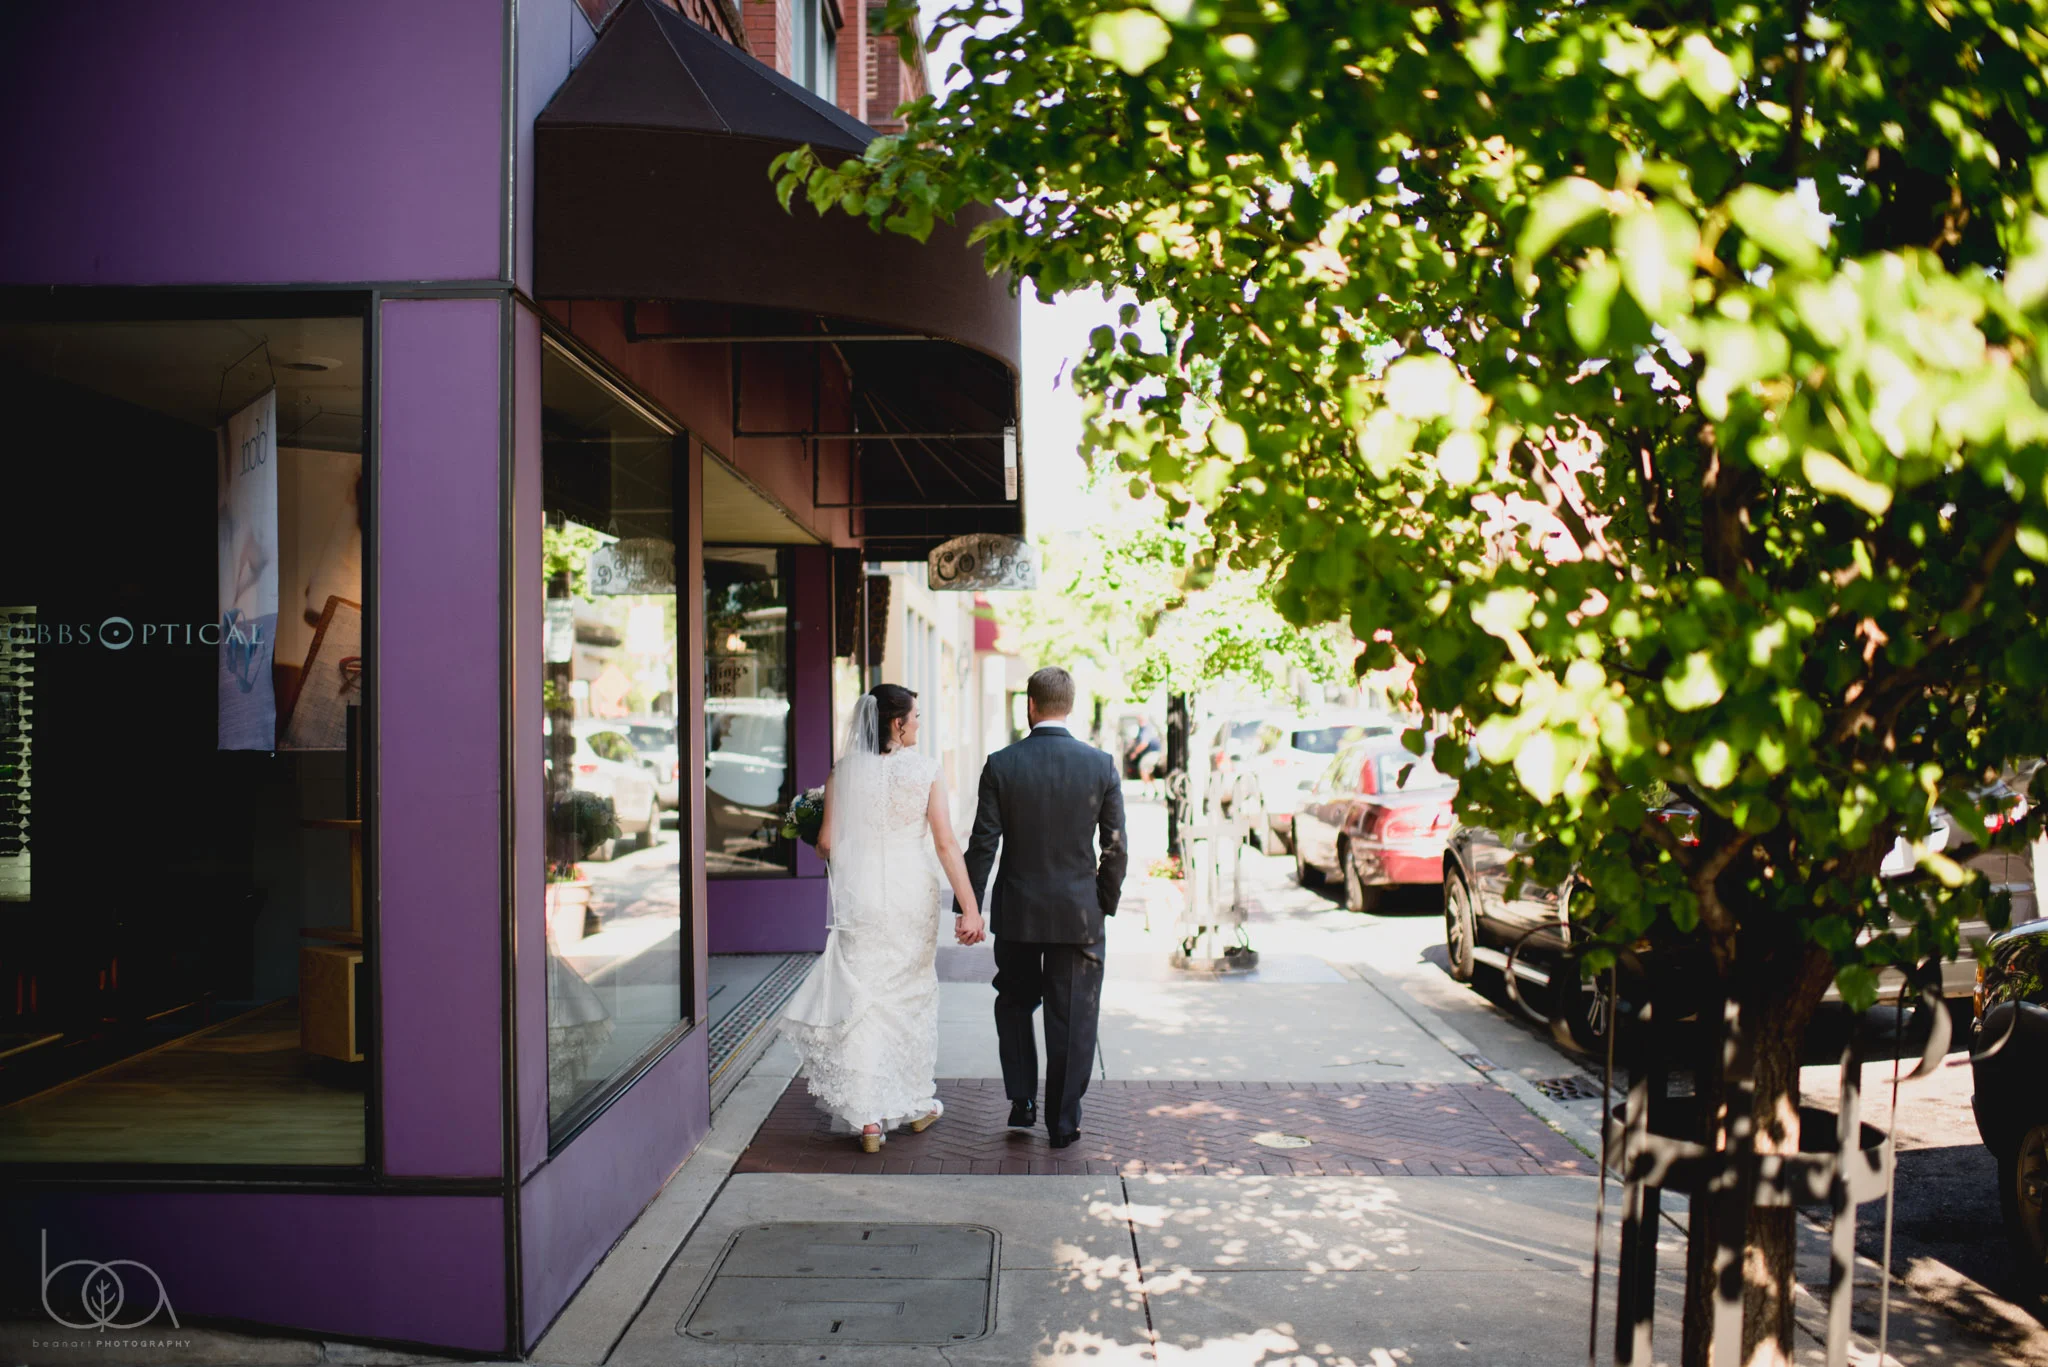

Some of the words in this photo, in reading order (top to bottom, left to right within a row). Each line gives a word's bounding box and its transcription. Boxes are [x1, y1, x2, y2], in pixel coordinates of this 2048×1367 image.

[937, 540, 1030, 581] Coffee
[0, 624, 91, 646] OBBS
[99, 616, 265, 650] OPTICAL
